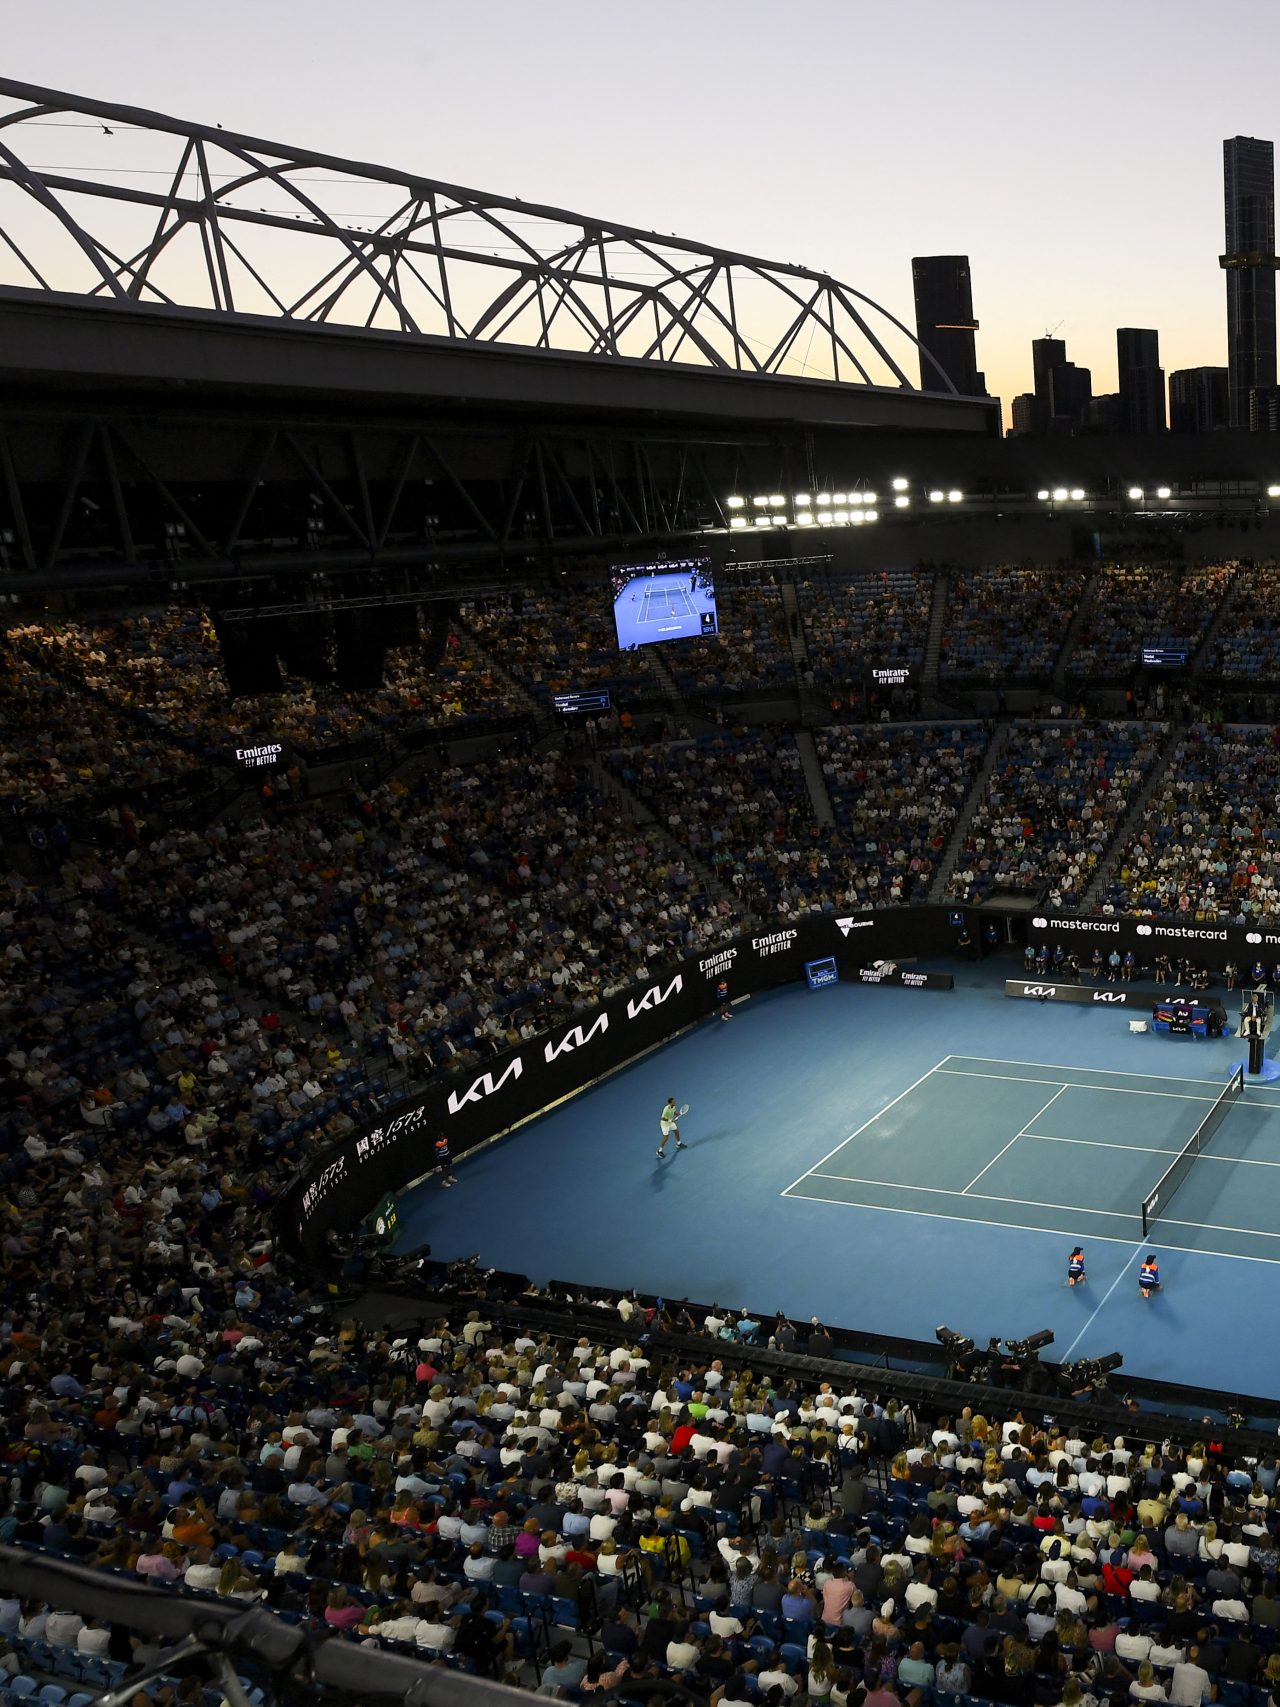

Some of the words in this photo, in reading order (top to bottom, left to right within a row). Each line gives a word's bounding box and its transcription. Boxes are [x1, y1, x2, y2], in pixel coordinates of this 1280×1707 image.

[872, 668, 909, 678] Emirates
[235, 743, 282, 760] Emirates
[256, 754, 277, 766] BETTER
[1050, 918, 1120, 932] mastercard
[1155, 926, 1227, 940] mastercard
[752, 928, 798, 950] Emirates
[760, 946, 769, 957] FLY
[770, 940, 791, 954] BETTER
[699, 947, 737, 972] Emirates
[706, 969, 714, 980] FLY
[714, 960, 732, 976] BETTER
[626, 974, 683, 1020] KIA
[544, 1012, 609, 1063] KIA
[448, 1057, 523, 1115] KIA
